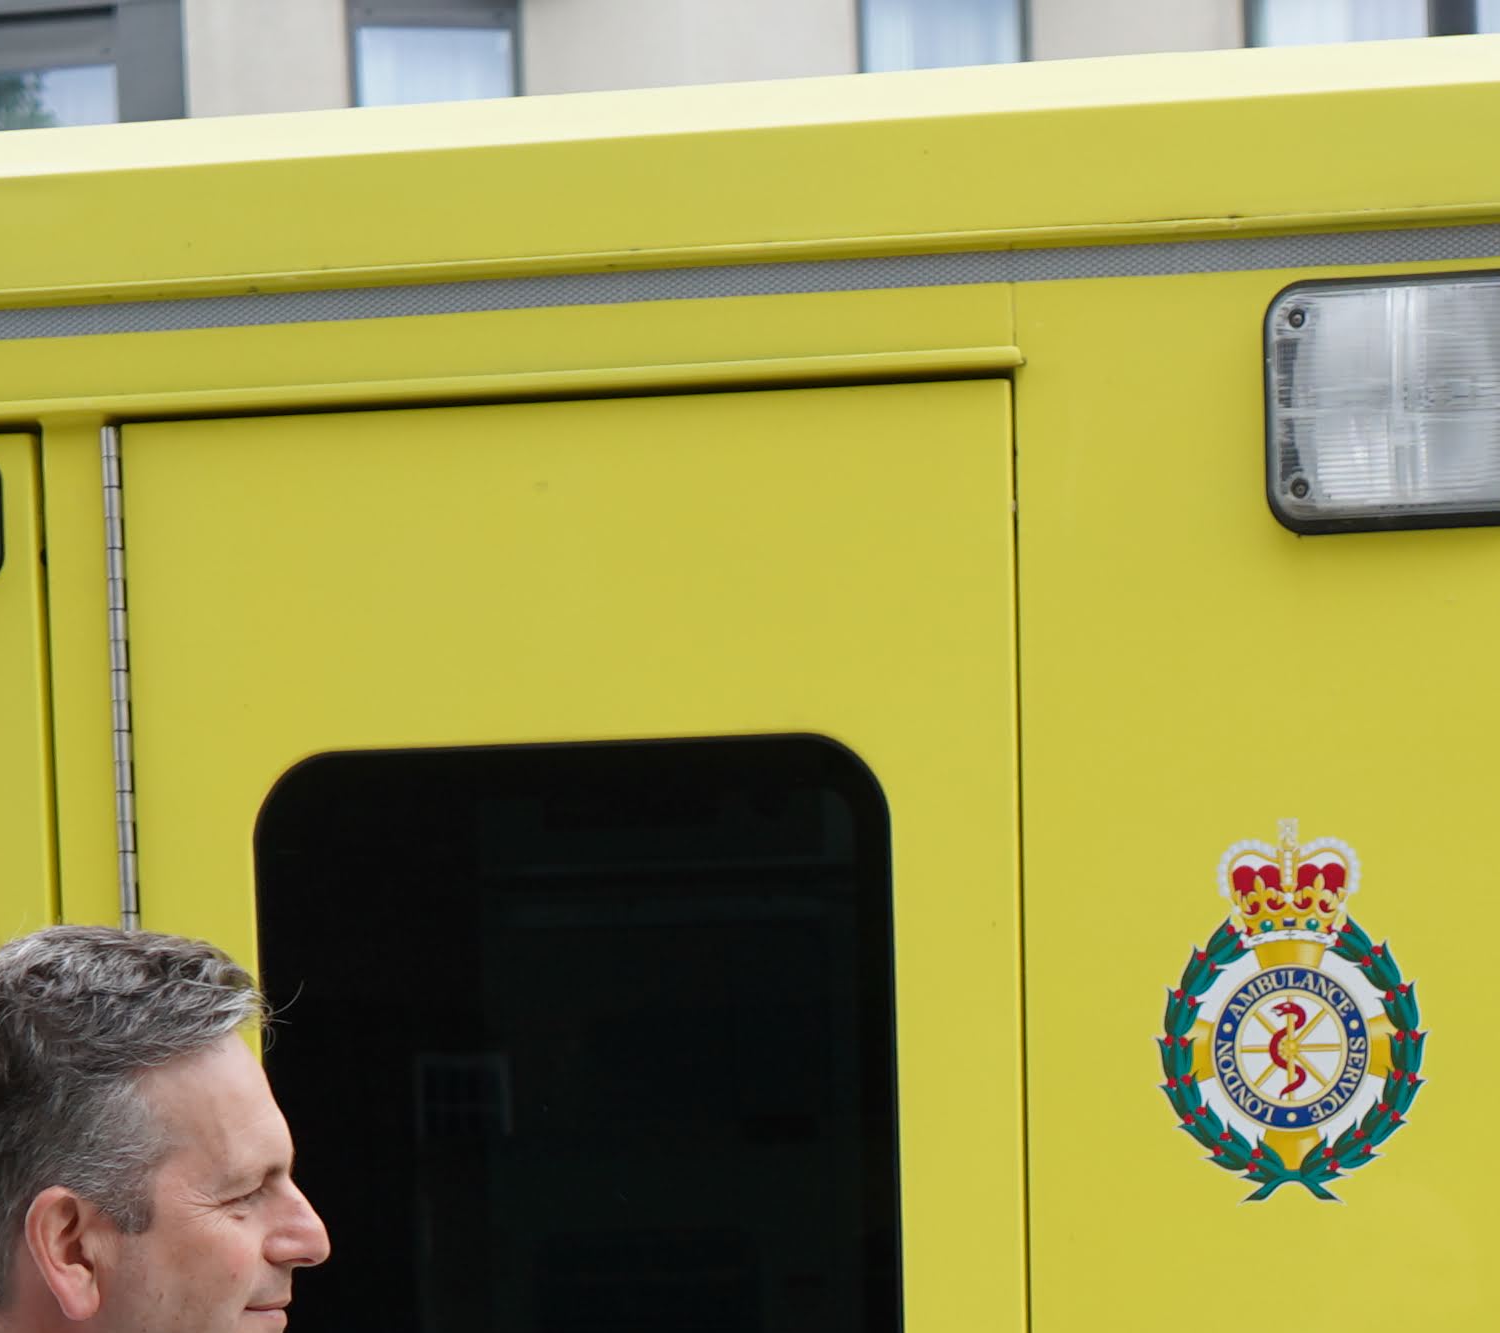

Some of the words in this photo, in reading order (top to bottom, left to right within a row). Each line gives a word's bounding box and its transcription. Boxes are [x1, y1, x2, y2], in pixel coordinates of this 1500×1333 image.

[1228, 969, 1356, 1021] AMBULANCE
[1216, 1039, 1276, 1124] LONDON
[1307, 1036, 1367, 1123] SERVICE
